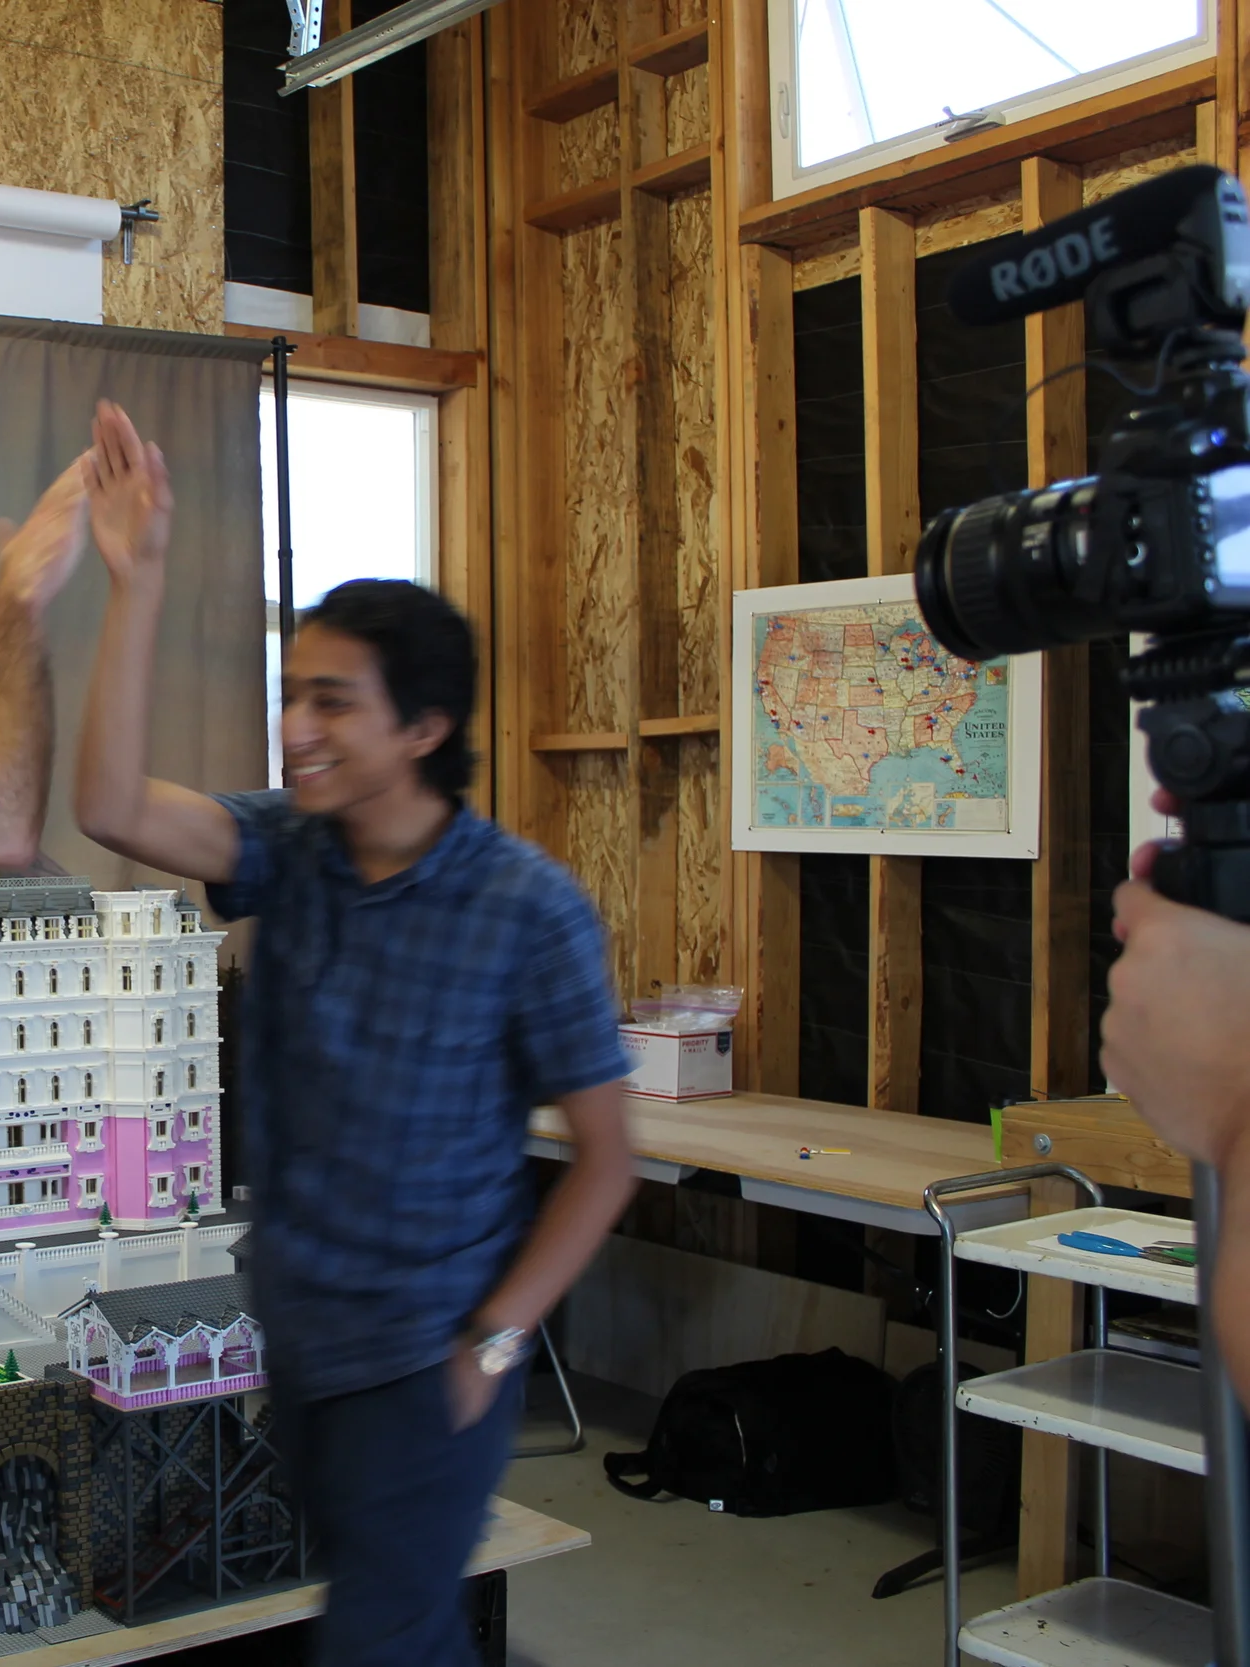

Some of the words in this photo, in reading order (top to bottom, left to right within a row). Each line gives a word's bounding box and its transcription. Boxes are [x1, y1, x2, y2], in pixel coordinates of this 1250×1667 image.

[991, 216, 1120, 301] RØDE
[964, 722, 1005, 730] UNITED
[965, 731, 1005, 739] STATES
[682, 1039, 709, 1047] PRIORITY
